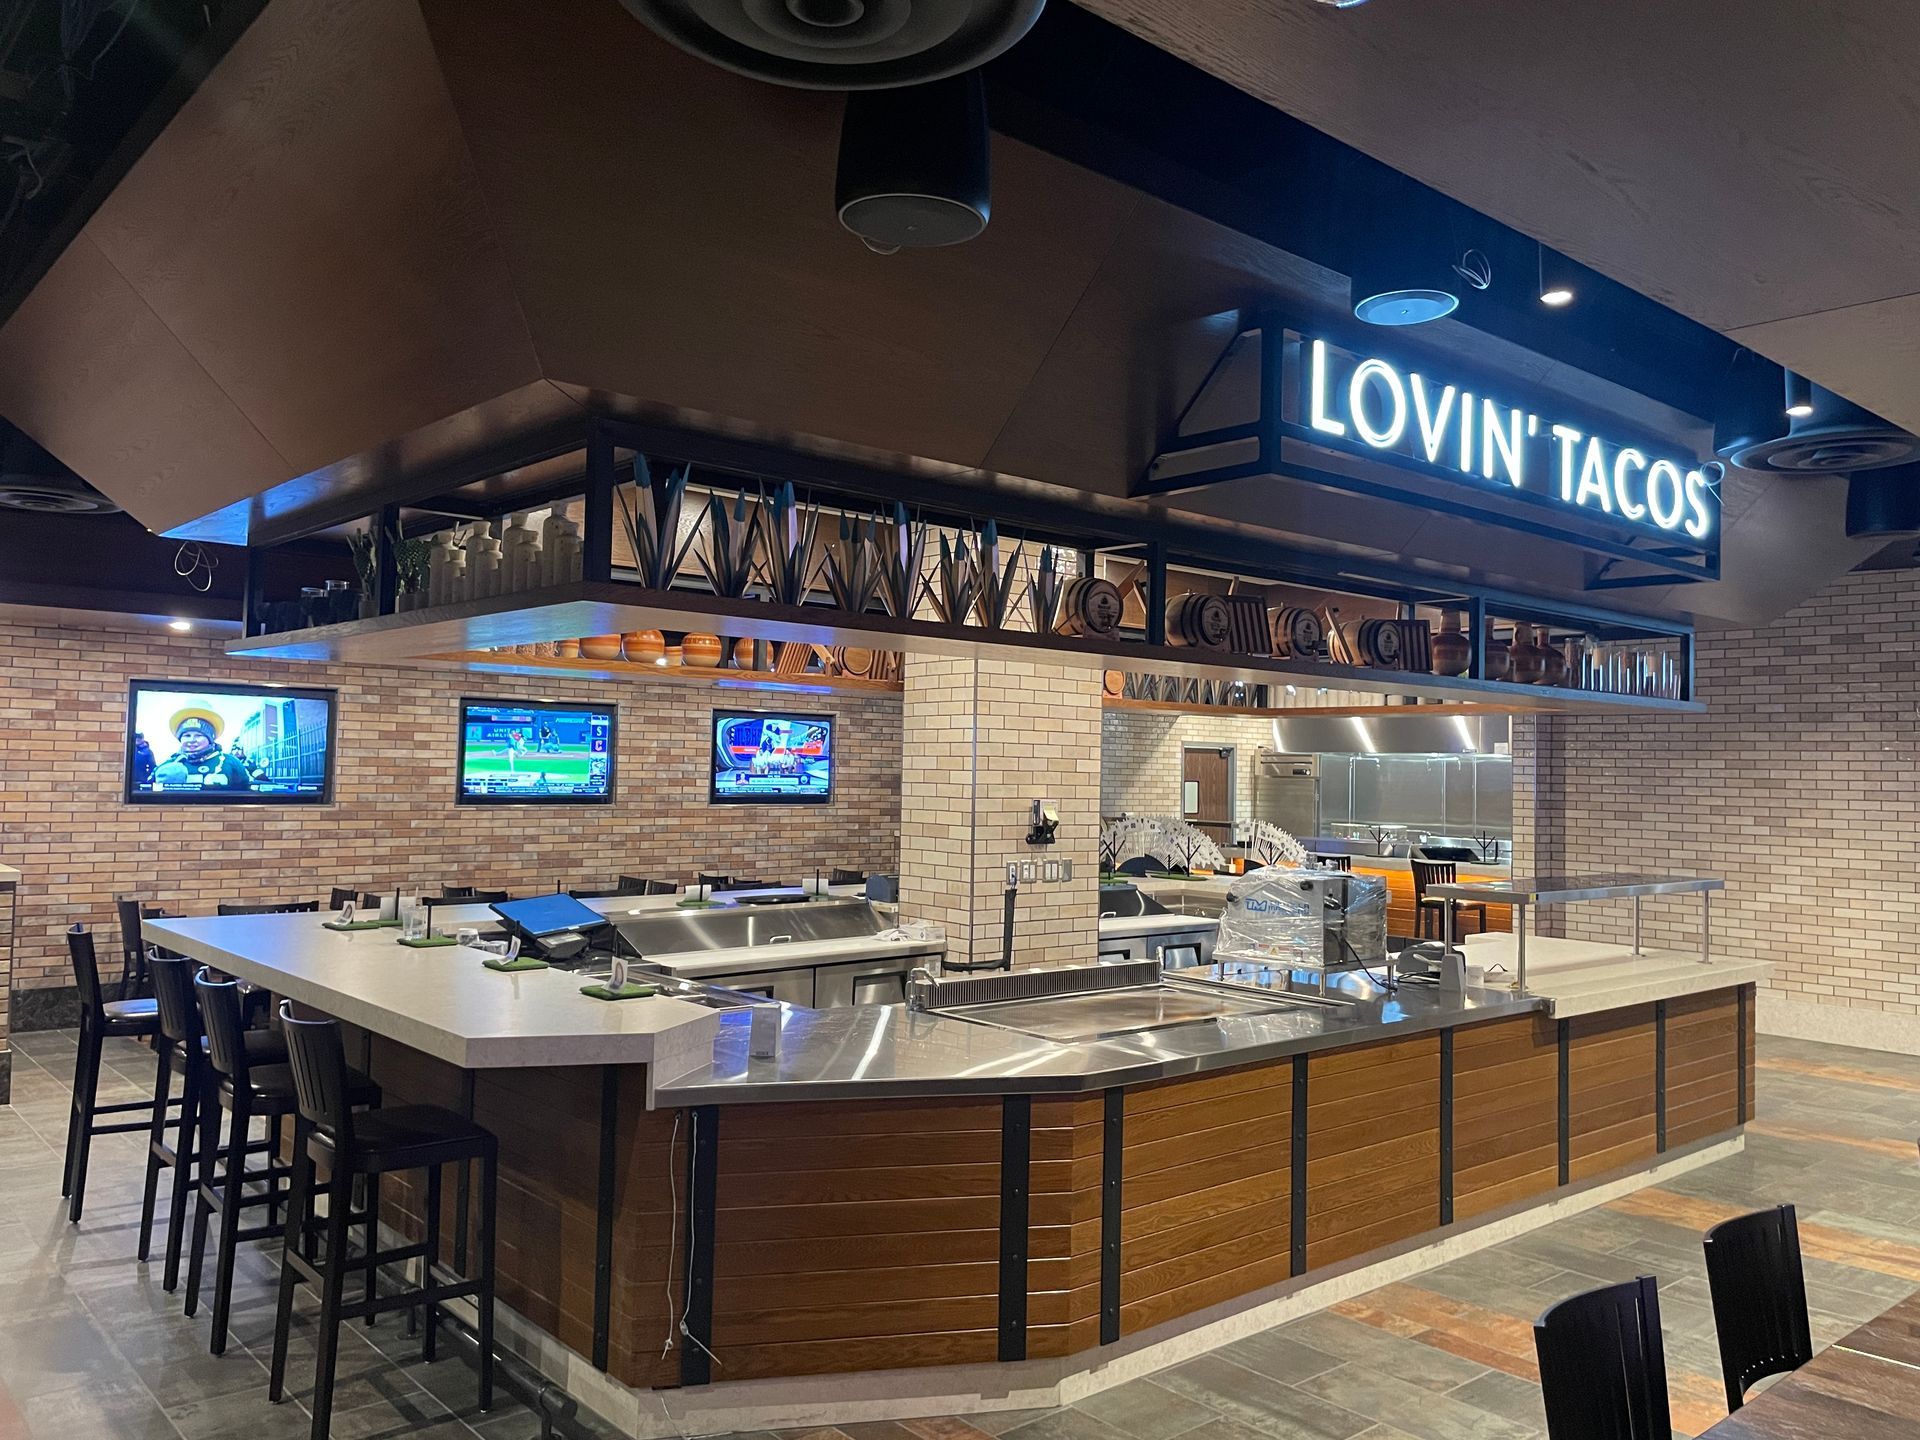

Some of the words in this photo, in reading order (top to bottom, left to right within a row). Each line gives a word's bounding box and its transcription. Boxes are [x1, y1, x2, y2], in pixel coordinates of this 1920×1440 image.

[1311, 338, 1537, 488] LOVIN'
[1552, 424, 1710, 539] TACOS
[1245, 898, 1268, 912] TM
